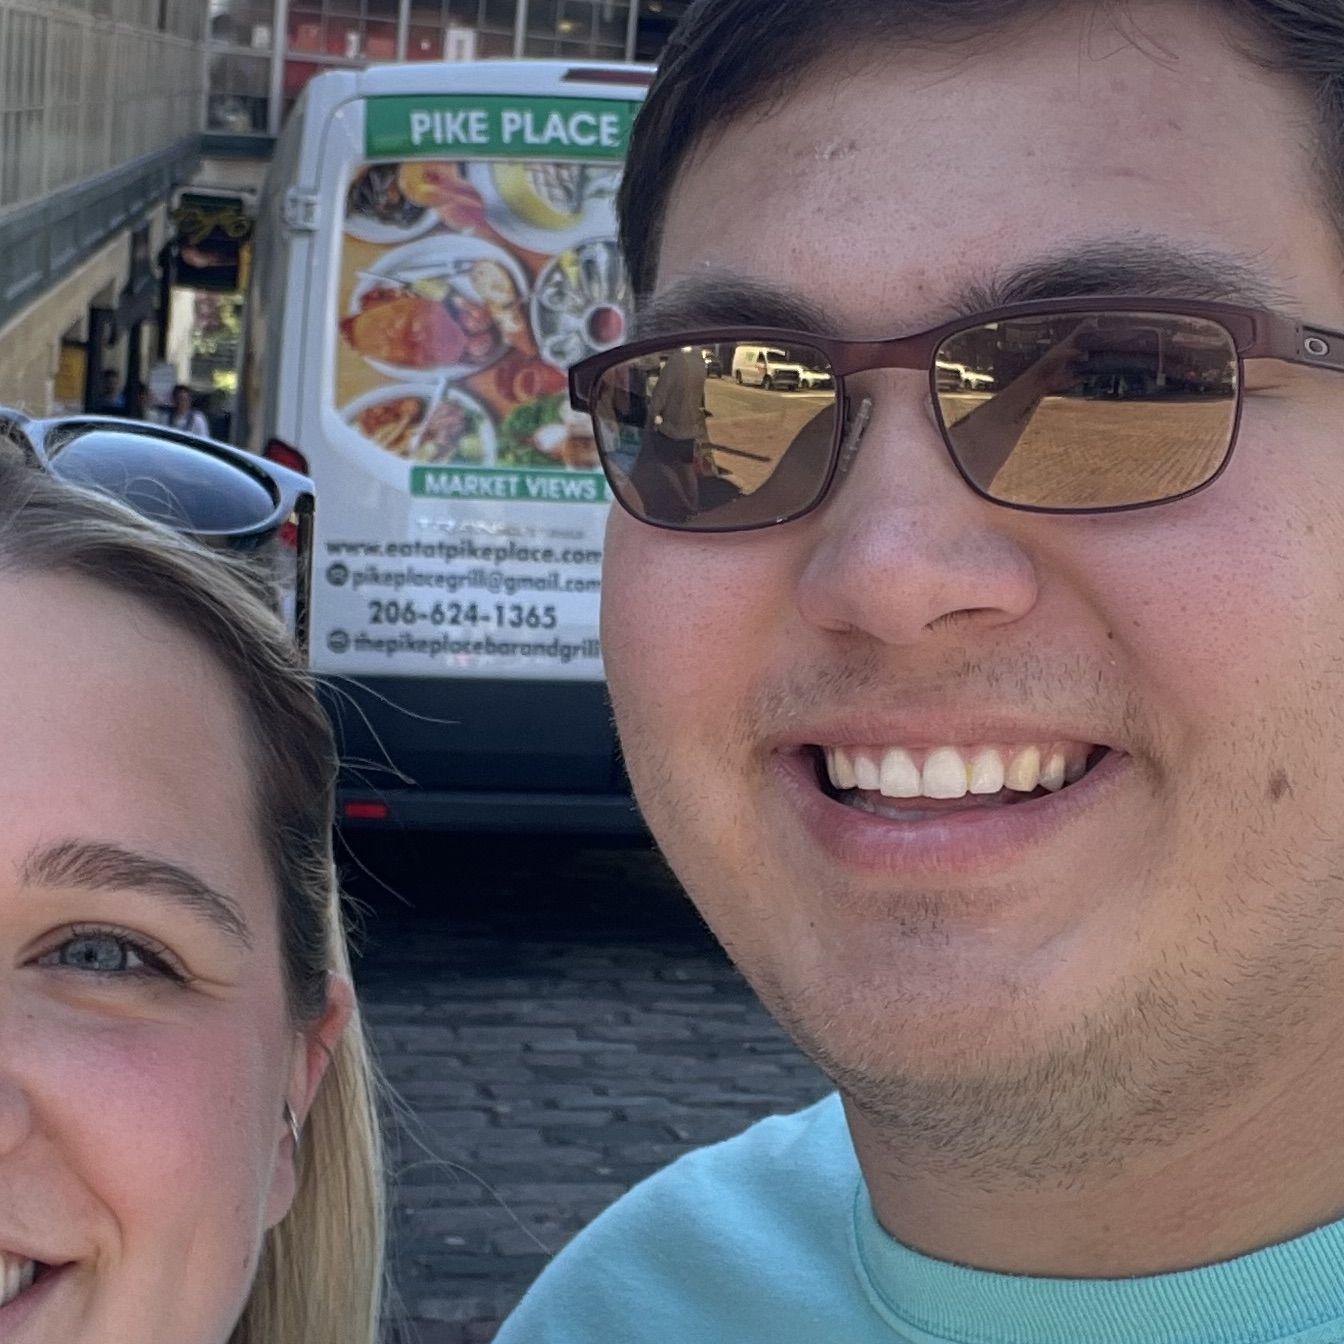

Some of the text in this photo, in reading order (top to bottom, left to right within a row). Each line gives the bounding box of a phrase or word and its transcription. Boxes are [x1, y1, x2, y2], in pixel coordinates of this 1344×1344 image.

[410, 110, 620, 147] PIKE PLACE
[424, 472, 520, 497] MARKET
[525, 476, 597, 500] VIEWS
[326, 540, 603, 563] www.eatatpikeplace.com
[368, 600, 557, 630] 206-624-1365
